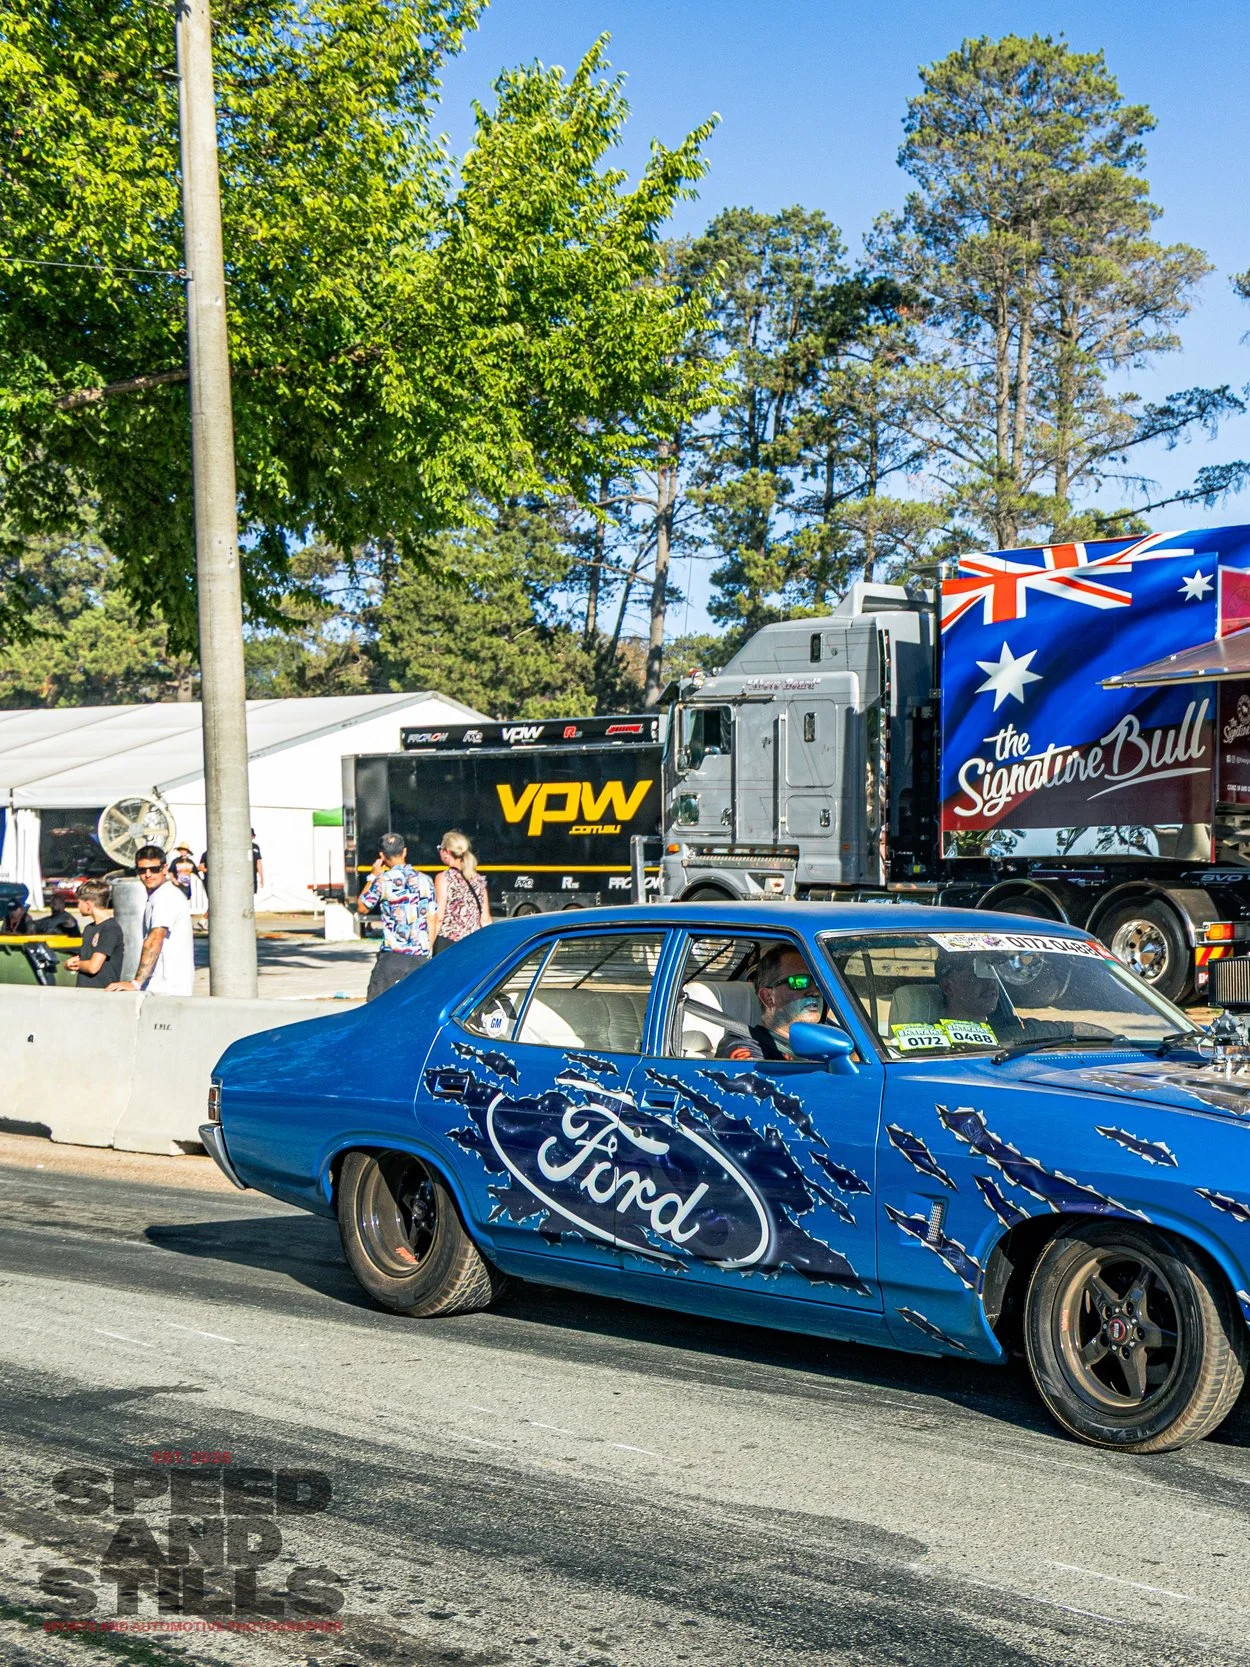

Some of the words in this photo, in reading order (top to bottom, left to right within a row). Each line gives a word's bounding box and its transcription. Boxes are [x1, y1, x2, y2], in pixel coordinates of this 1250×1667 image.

[983, 723, 1030, 762] the
[954, 743, 1105, 817] Signature
[1101, 697, 1209, 778] Bull
[1005, 936, 1051, 951] 0172
[908, 1036, 944, 1047] 0172
[953, 1032, 993, 1044] 0488
[537, 1103, 701, 1243] Ford
